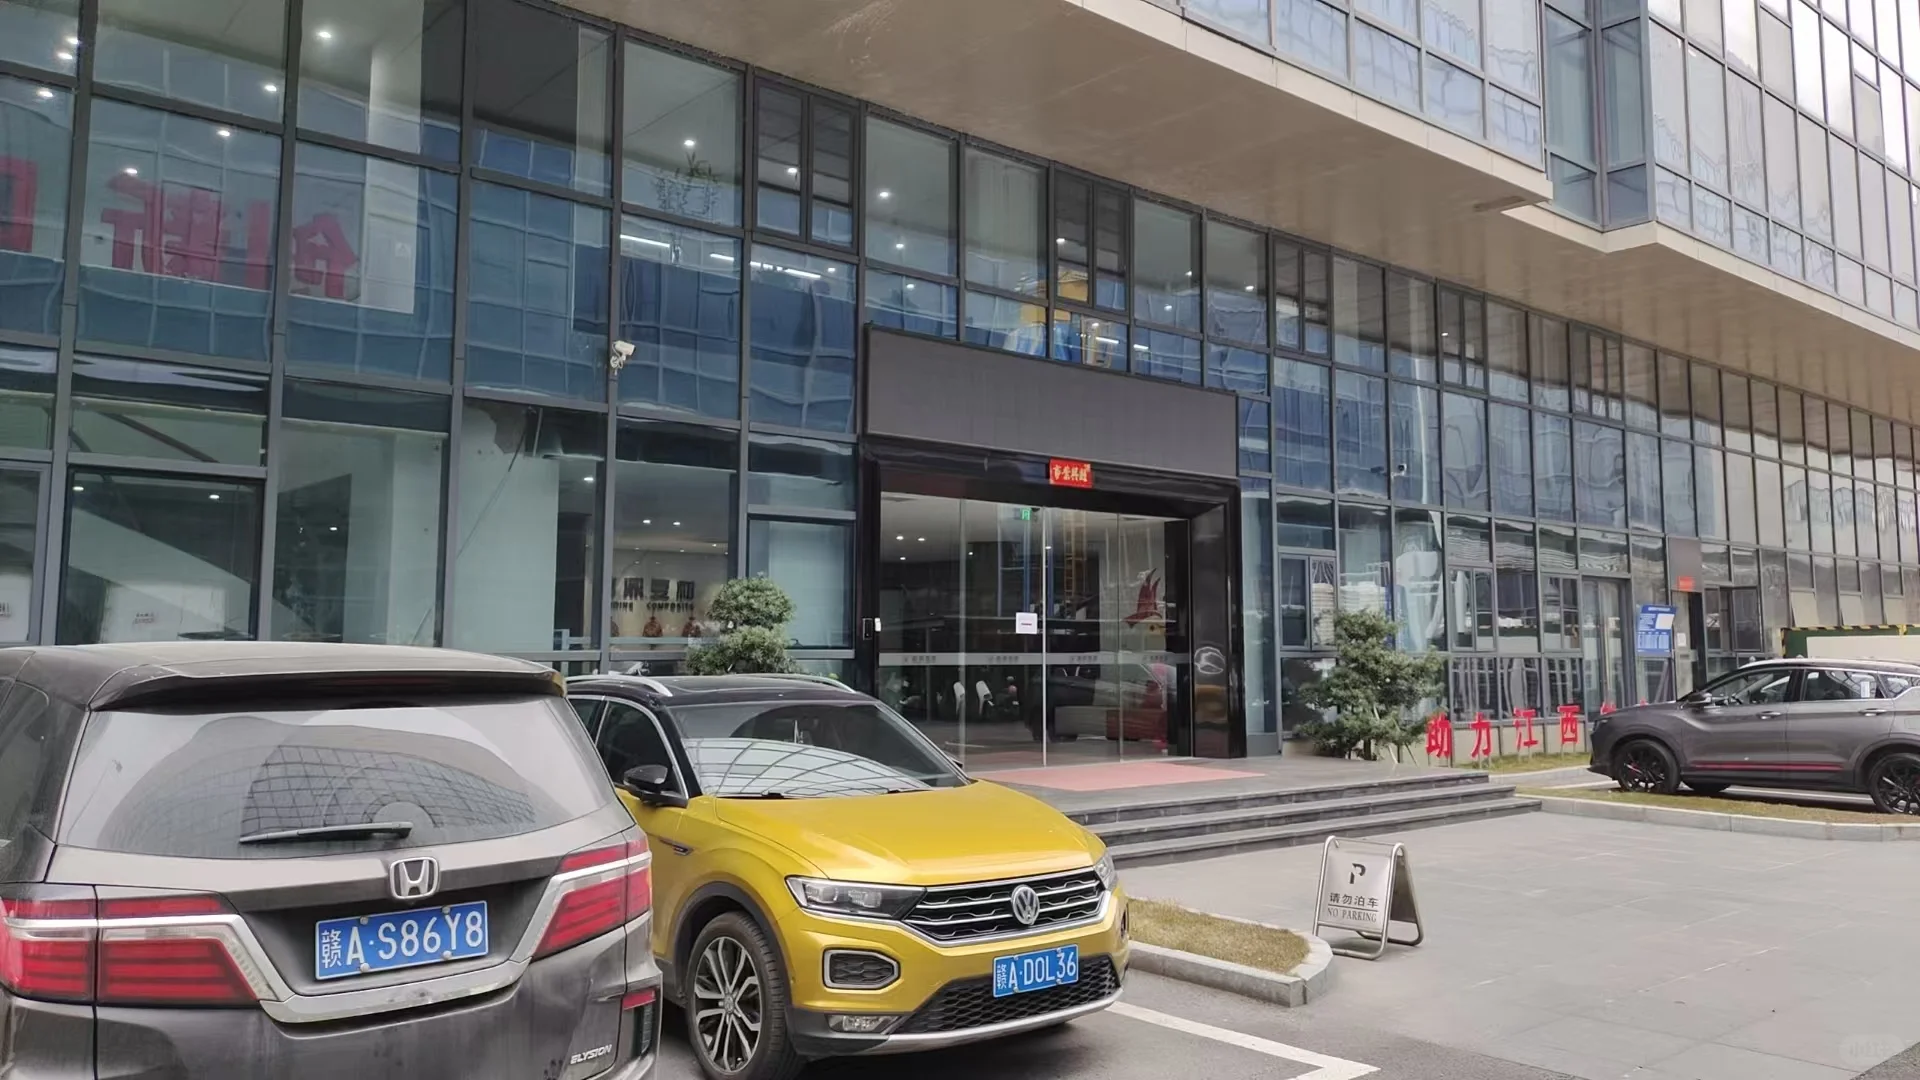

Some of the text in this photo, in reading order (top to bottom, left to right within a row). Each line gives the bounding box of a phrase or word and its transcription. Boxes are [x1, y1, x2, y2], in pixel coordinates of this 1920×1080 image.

[1425, 697, 1648, 758] 助力江西
[1349, 862, 1366, 884] P
[1329, 892, 1379, 908] 请勿泊车
[1327, 907, 1377, 923] NO PARKING
[570, 1044, 612, 1065] ELYSION
